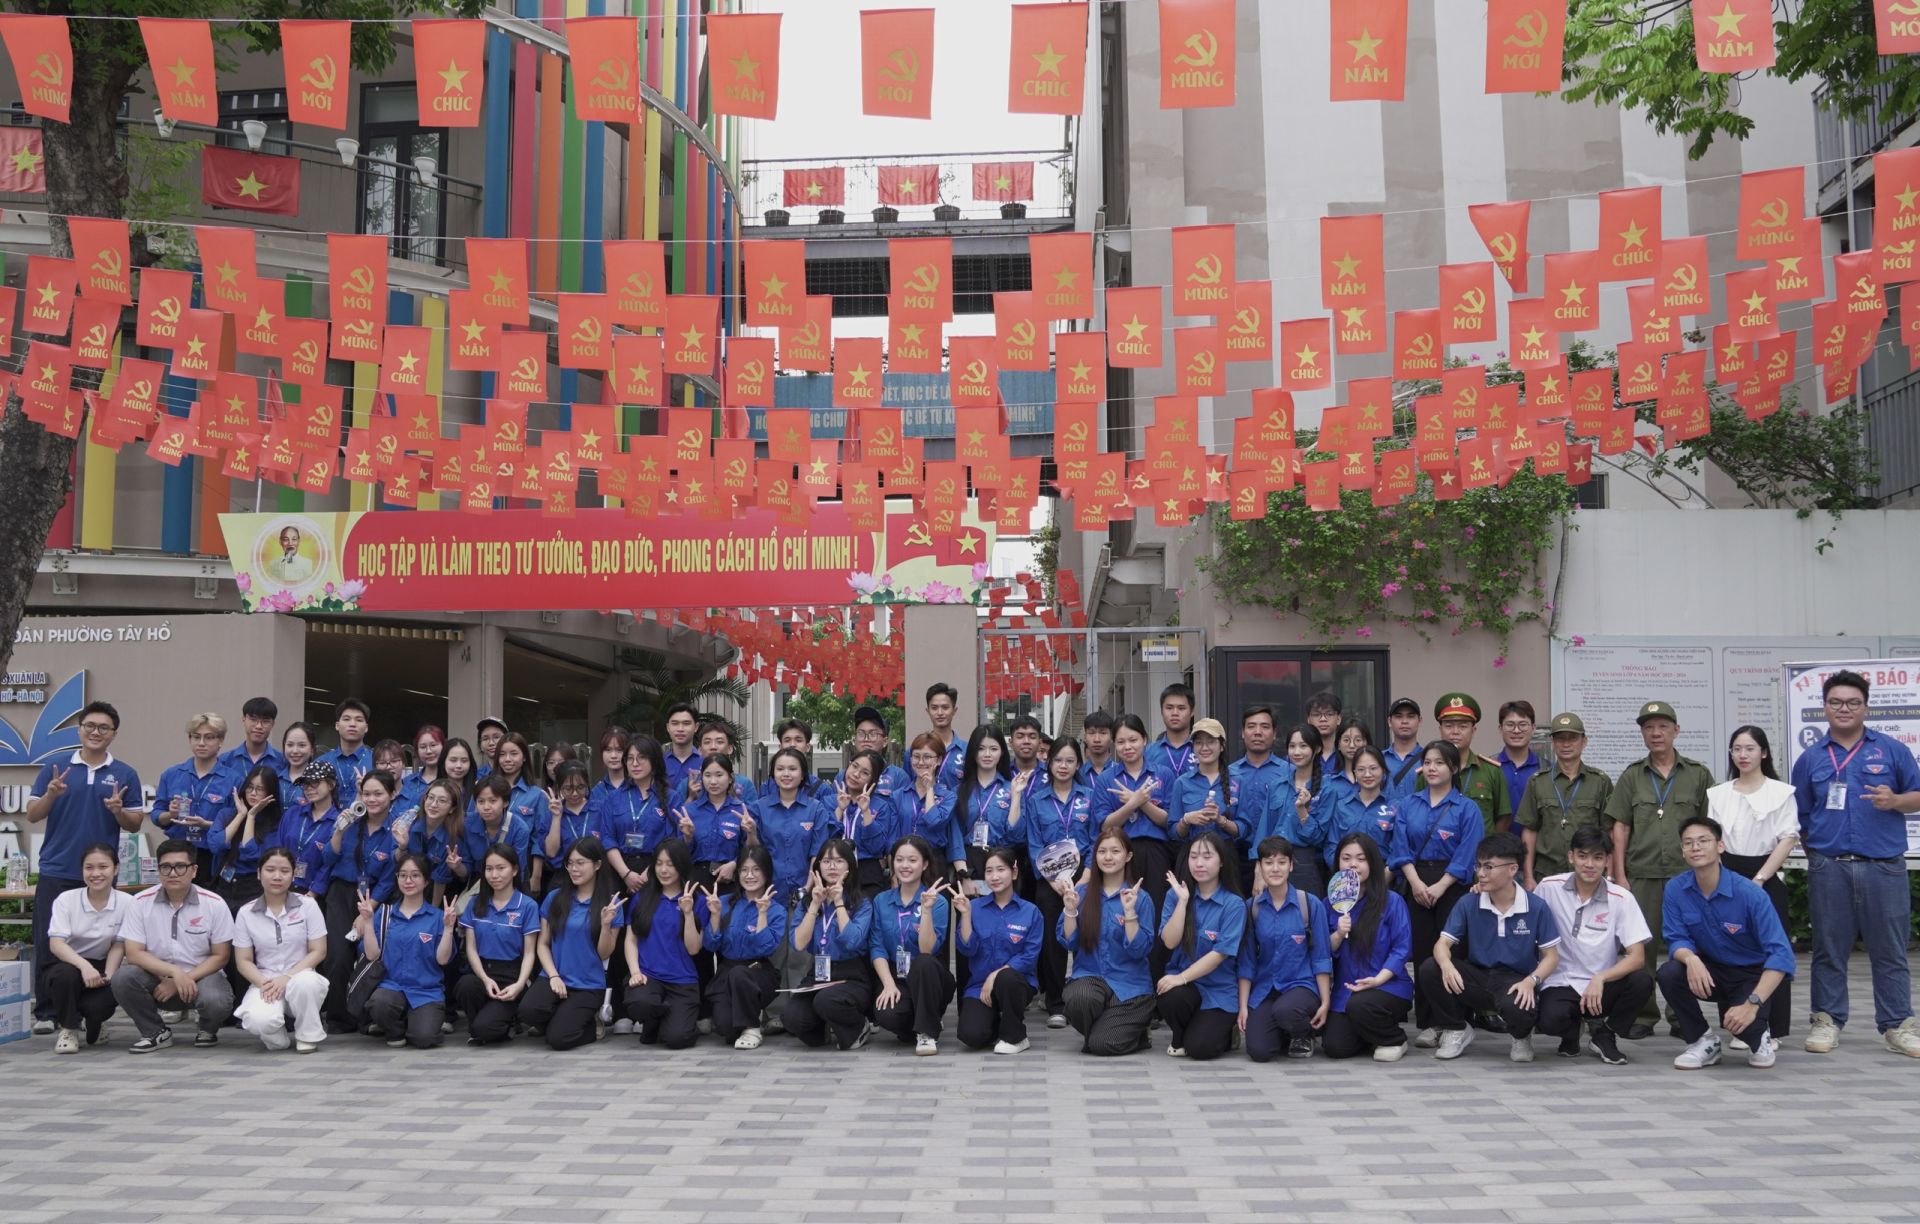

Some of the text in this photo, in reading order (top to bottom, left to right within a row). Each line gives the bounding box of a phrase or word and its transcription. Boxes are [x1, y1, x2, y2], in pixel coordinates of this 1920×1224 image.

[1891, 18, 1920, 37] MỚ
[1708, 38, 1753, 58] NĂM
[1503, 52, 1541, 70] MỚI
[1171, 70, 1224, 89] MỪNG
[1345, 64, 1388, 84] NĂM
[726, 84, 765, 104] NĂM
[878, 84, 913, 103] MỚI
[1022, 78, 1072, 97] CHÚC
[31, 85, 67, 107] MỪNG
[171, 91, 205, 108] NĂM
[302, 94, 332, 111] MỚI
[433, 93, 472, 112] CHÚC
[588, 93, 635, 112] MỪNG
[1893, 215, 1920, 231] NĂM
[1748, 230, 1795, 247] MỪNG
[1612, 249, 1653, 267] CHÚC
[91, 276, 126, 294] MỪNG
[1330, 280, 1366, 295] NĂM
[1776, 276, 1808, 290] NĂM
[217, 287, 247, 303] NĂM
[483, 293, 518, 308] CHÚC
[1045, 292, 1083, 305] CHÚC
[1184, 287, 1228, 301] MỪNG
[1664, 291, 1703, 306] MỪNG
[618, 297, 659, 314] MỪNG
[758, 301, 792, 316] NĂM
[904, 295, 934, 309] MỚI
[1848, 298, 1882, 314] MỪNG
[1554, 306, 1590, 319] CHÚC
[1739, 312, 1772, 327] CHÚC
[246, 328, 278, 344] CHÚC
[1227, 334, 1265, 349] MỪNG
[1341, 328, 1372, 342] NĂM
[341, 335, 378, 351] MỪNG
[1117, 341, 1151, 355] CHÚC
[675, 350, 708, 364] CHÚC
[788, 347, 825, 361] MỪNG
[897, 346, 928, 359] NĂM
[1402, 358, 1437, 369] MỪNG
[391, 371, 420, 384] CHÚC
[1291, 367, 1323, 379] CHÚC
[31, 380, 59, 394] CHÚC
[508, 380, 542, 393] MỪNG
[842, 386, 873, 398] CHÚC
[958, 384, 990, 396] MỪNG
[1628, 383, 1658, 396] MỪNG
[1536, 393, 1565, 405] CHÚC
[1482, 420, 1509, 430] CHÚC
[408, 429, 434, 441] CHÚC
[1261, 431, 1291, 441] MỪNG
[493, 441, 523, 453] MỪNG
[868, 446, 898, 456] MỪNG
[804, 474, 831, 485] CHÚC
[683, 494, 708, 504] CHÚC
[358, 543, 385, 584] HỌC
[390, 537, 416, 584] TẬP
[420, 536, 438, 576] VÀ
[442, 537, 474, 576] LÀM
[476, 541, 511, 575] THEO
[515, 540, 533, 575] TƯ
[536, 529, 588, 578] TƯỞNG,
[591, 540, 620, 581] ĐẠO
[624, 533, 658, 577] ĐỨC,
[662, 538, 711, 573] PHONG
[716, 531, 753, 571] CÁCH
[759, 526, 778, 572] HỒ
[783, 529, 807, 570] CHÍ
[49, 624, 113, 642] PHƯỜNG
[117, 624, 143, 641] TÂY
[147, 620, 171, 641] HỒ
[1877, 667, 1908, 685] BÁO
